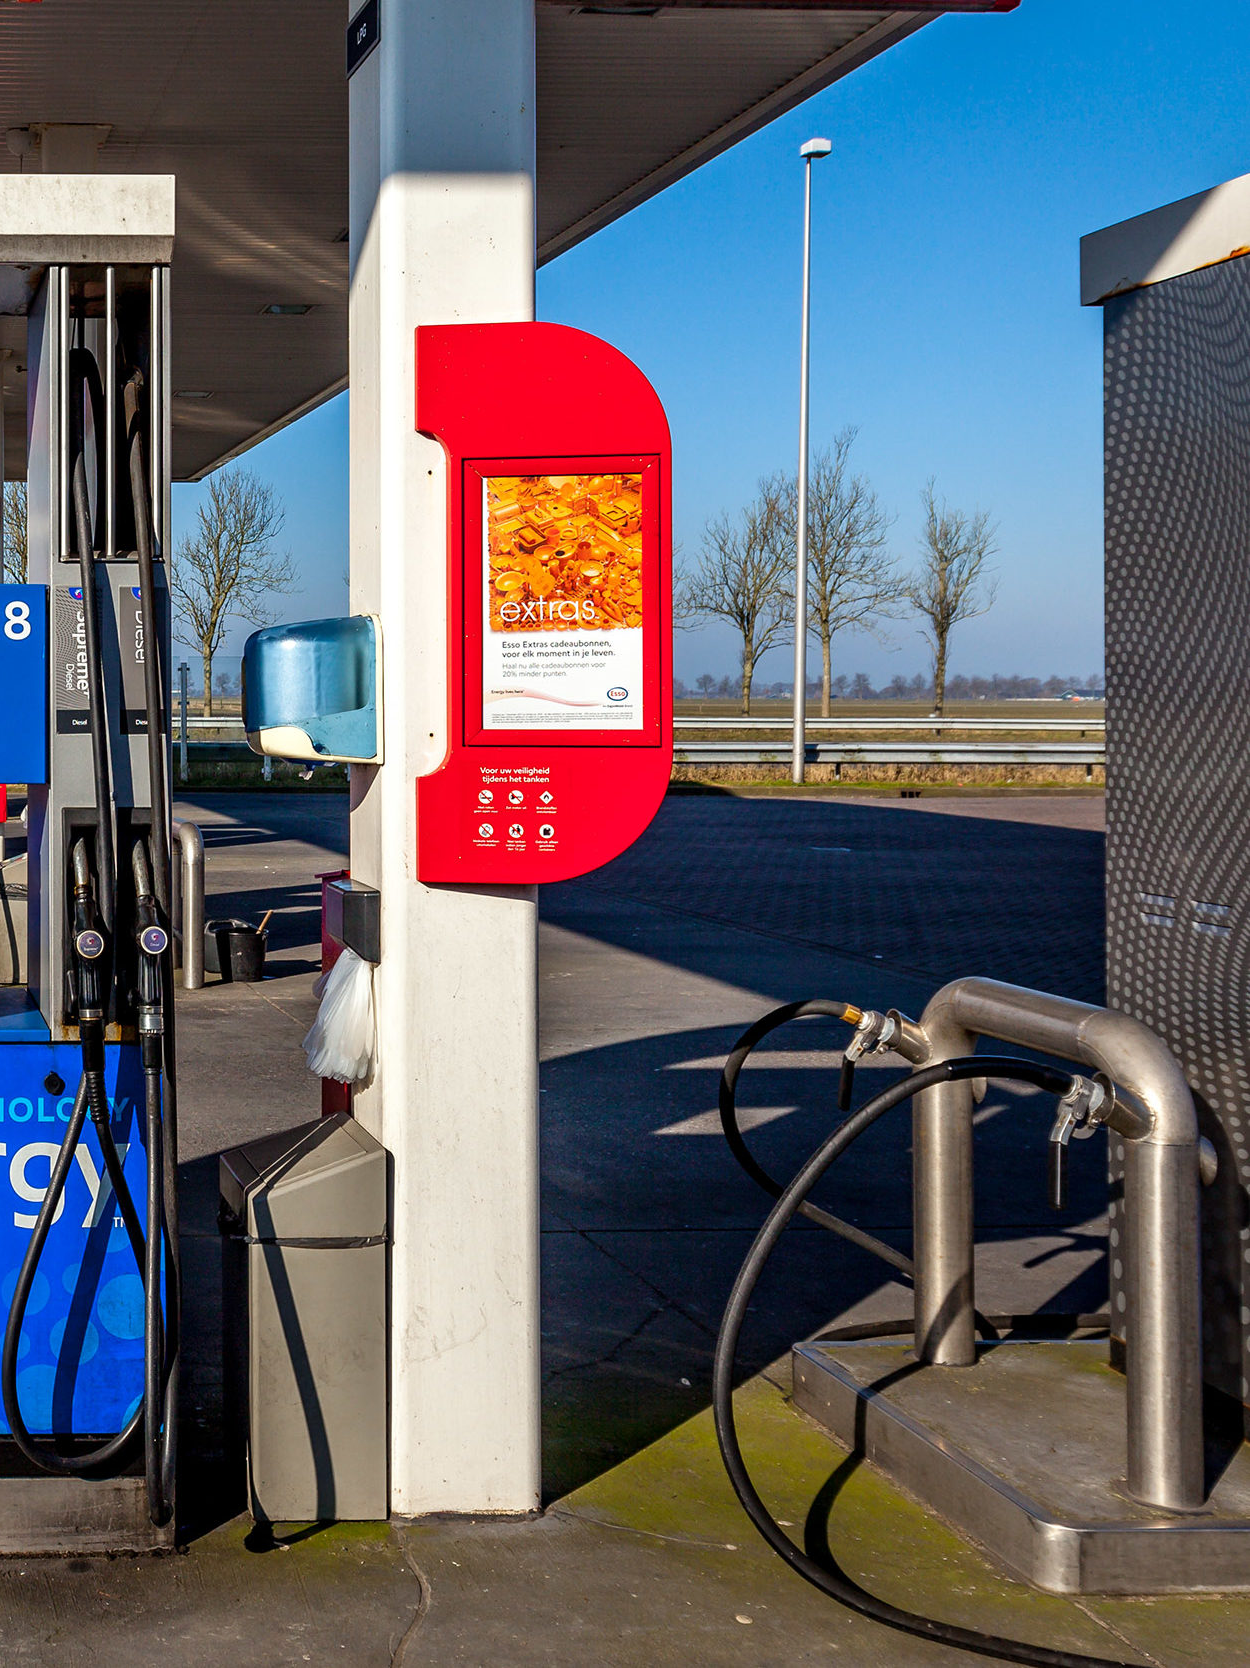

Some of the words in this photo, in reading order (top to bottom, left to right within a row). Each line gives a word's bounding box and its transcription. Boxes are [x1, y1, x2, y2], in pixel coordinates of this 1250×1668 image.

[356, 23, 367, 45] LPG
[500, 595, 595, 622] extras
[4, 601, 31, 640] 8
[502, 641, 520, 649] Esso
[550, 640, 612, 648] cadeaubonnen,
[522, 650, 534, 658] elk
[581, 650, 590, 659] je
[591, 649, 616, 657] leven.
[541, 661, 589, 669] cadeaubonnen
[66, 664, 75, 691] Diesel
[513, 767, 550, 776] veiligheid
[482, 776, 507, 784] tijdens
